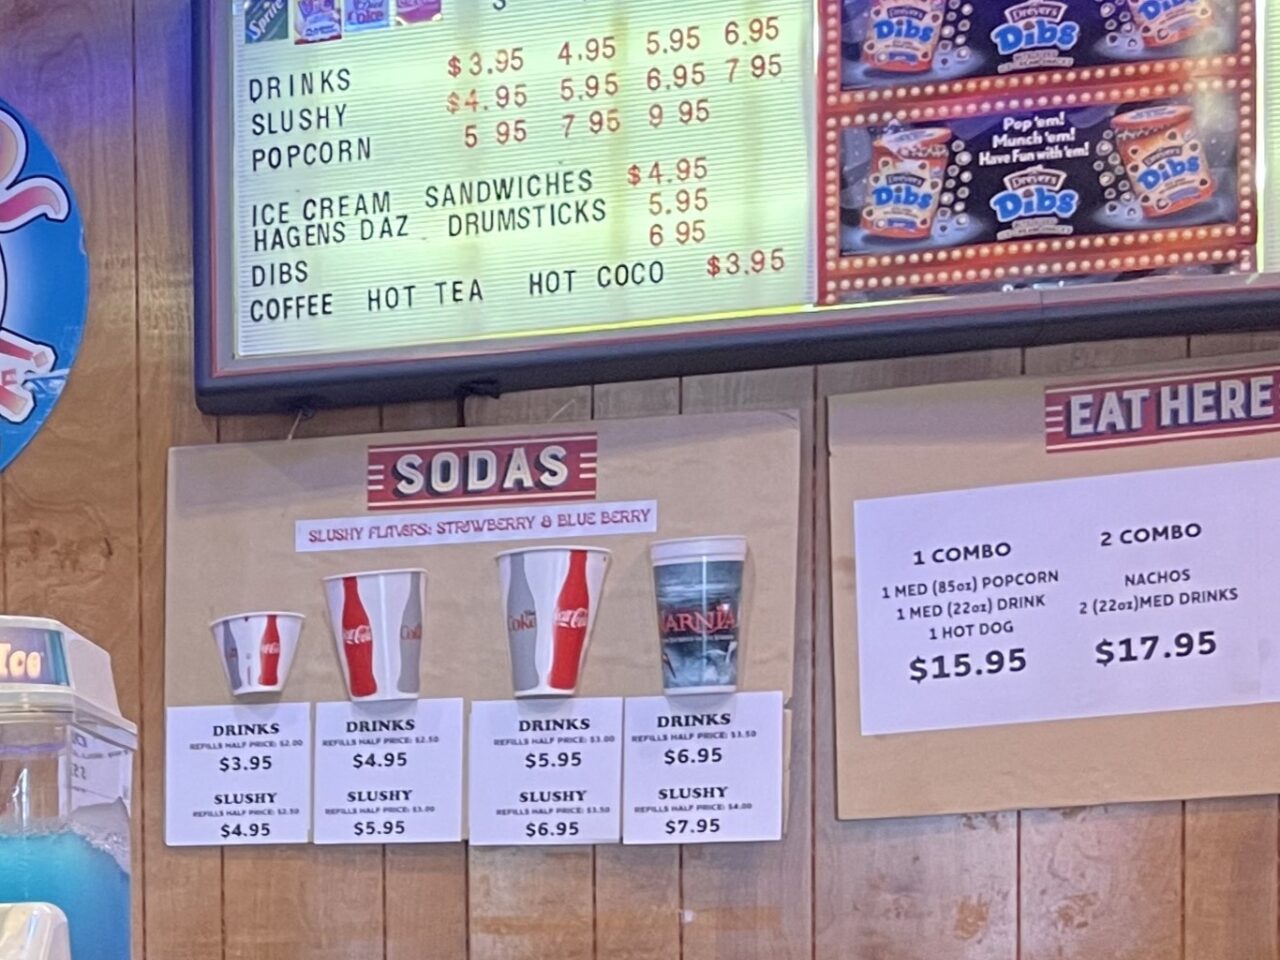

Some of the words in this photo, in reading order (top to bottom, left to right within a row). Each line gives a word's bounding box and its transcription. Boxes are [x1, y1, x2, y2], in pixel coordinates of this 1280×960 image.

[873, 19, 934, 43] Dibs
[992, 18, 1078, 53] Dibs
[250, 69, 352, 102] DRINKS
[447, 48, 524, 78] $3.95
[558, 36, 616, 65] 4.95
[646, 26, 701, 55] 5.95
[724, 16, 780, 46] 6.95
[251, 104, 348, 136] SLUSHY
[560, 73, 619, 101] 5.95
[646, 63, 705, 91] 6.95
[1003, 116, 1032, 132] Pop
[992, 130, 1043, 148] Munch
[252, 137, 372, 171] POPCORN
[979, 151, 1011, 166] Have
[1012, 149, 1035, 163] Fun
[1036, 145, 1063, 160] with
[1136, 156, 1200, 190] Dibs
[252, 202, 290, 227] ICE
[302, 191, 392, 222] CREAM
[425, 169, 593, 209] SANDWICHES
[626, 156, 708, 186] $4.95
[872, 186, 933, 209] Dibs
[991, 186, 1078, 222] Dibs
[253, 220, 346, 252] HAGENS
[360, 215, 409, 241] DAZ
[448, 199, 607, 237] DRUMSTICKS
[649, 187, 708, 216] 5.95
[250, 293, 333, 323] COFFEE
[368, 285, 416, 312] HOT
[435, 279, 483, 306] TEA
[529, 270, 577, 297] HOT
[596, 260, 665, 289] COCO
[706, 247, 785, 278] $3.95
[251, 260, 309, 288] DIBS
[1069, 388, 1150, 436] EAT
[1160, 374, 1274, 427] HERE
[395, 444, 569, 496] SODAS
[308, 527, 364, 544] SLUSHY
[368, 523, 432, 540] FLAVORS:
[436, 515, 536, 535] STRAWBERRY
[557, 512, 597, 527] BLUE
[600, 509, 652, 524] BERRY
[1100, 531, 1112, 547] 2
[1119, 522, 1202, 545] COMBO
[913, 550, 925, 565] 1
[932, 542, 1012, 564] COMBO
[882, 586, 891, 599] 1
[894, 583, 928, 598] MED
[981, 569, 1060, 591] POPCORN
[1123, 568, 1192, 587] NACHOS
[897, 607, 905, 620] 1
[909, 604, 943, 619] MED
[996, 594, 1047, 611] DRINK
[1079, 602, 1088, 615] 2
[1179, 587, 1239, 606] DRINKS
[929, 627, 938, 640] 1
[942, 624, 975, 639] HOT
[978, 621, 1014, 636] DOG
[1095, 630, 1217, 667] $17.95
[908, 647, 1027, 684] $15.95
[213, 723, 280, 737] DRINKS
[346, 719, 415, 733] DRINKS
[519, 718, 590, 732] DRINKS
[657, 713, 731, 728] DRINKS
[219, 755, 272, 772] $3.95
[353, 752, 407, 769] $4.95
[525, 752, 582, 769] $5.95
[664, 747, 723, 765] $6.95
[214, 792, 278, 805] SLUSHY
[347, 790, 413, 802] SLUSHY
[519, 790, 587, 802] SLUSHY
[658, 786, 728, 800] SLUSHY
[221, 823, 270, 838] $4.95
[354, 820, 405, 836] $5.95
[525, 821, 579, 837] $6.95
[665, 818, 720, 835] $7.95
